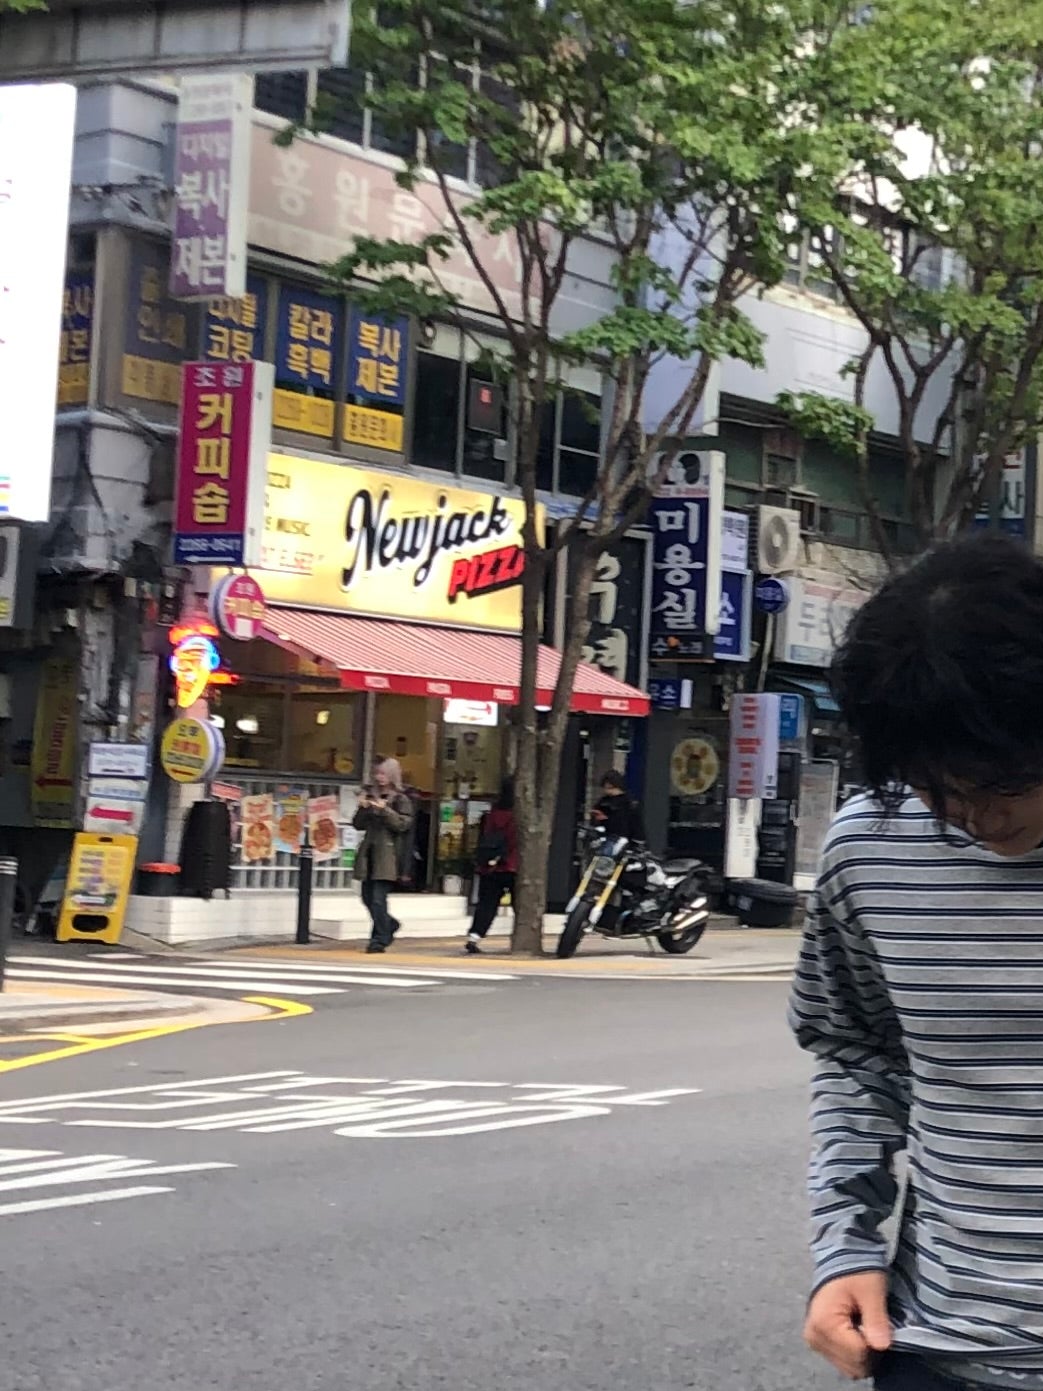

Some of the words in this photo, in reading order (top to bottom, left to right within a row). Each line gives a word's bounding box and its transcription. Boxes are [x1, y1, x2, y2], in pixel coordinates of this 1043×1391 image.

[176, 169, 228, 220] 복사
[176, 236, 226, 286] 제본
[289, 303, 333, 346] 칼라
[358, 321, 401, 362] 복사
[287, 343, 332, 384] 흑백
[356, 357, 399, 397] 제본
[340, 488, 509, 589] Newjack
[654, 502, 706, 630] 미용실
